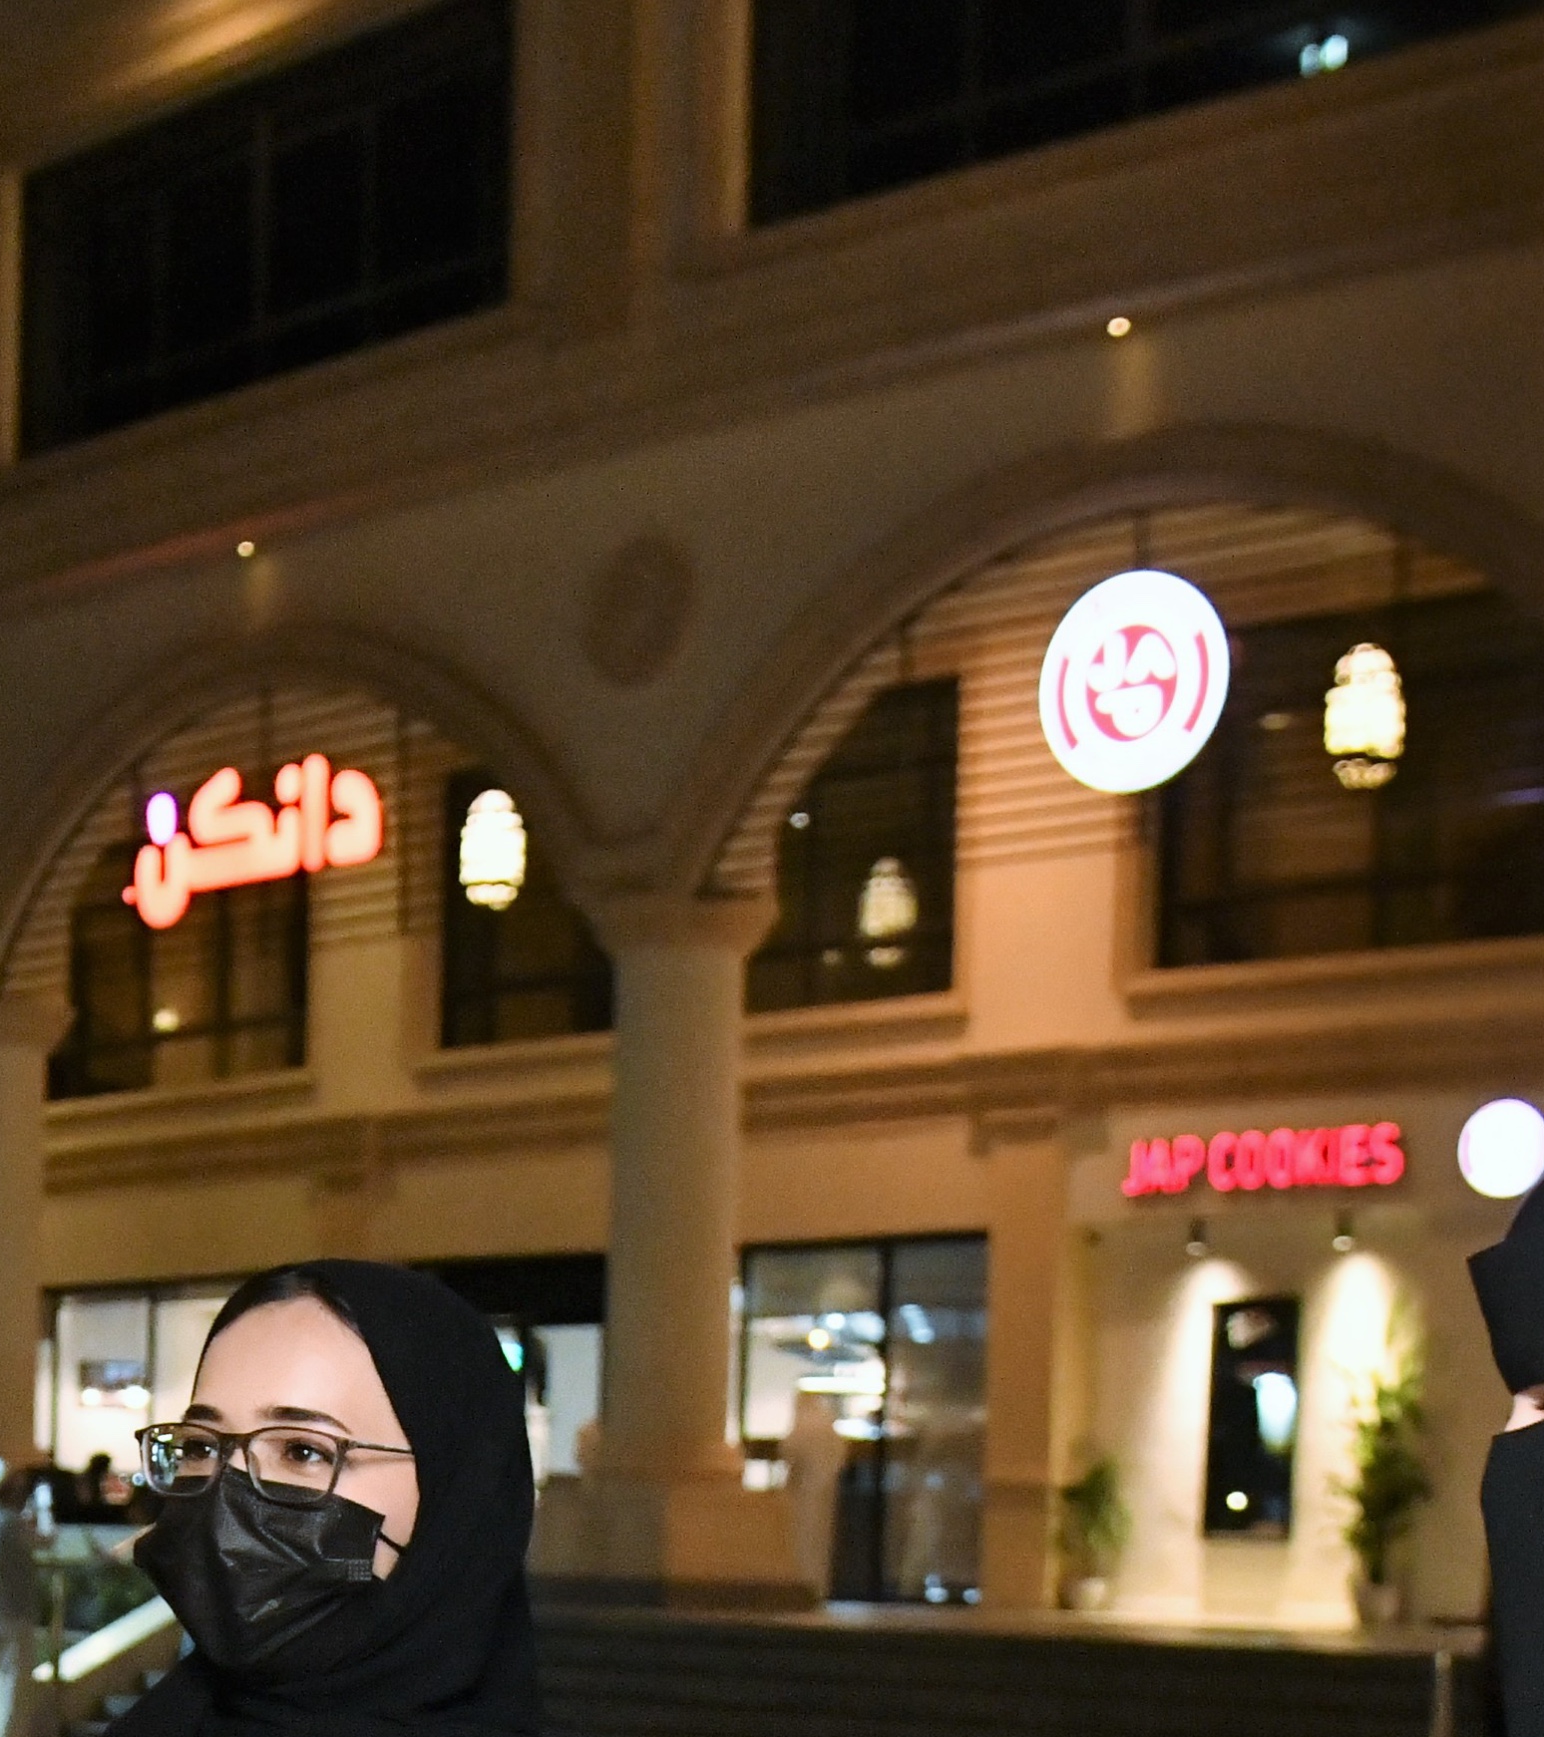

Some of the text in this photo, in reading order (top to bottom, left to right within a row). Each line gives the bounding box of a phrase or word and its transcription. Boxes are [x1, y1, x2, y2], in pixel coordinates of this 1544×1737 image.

[121, 753, 383, 929] دانكن
[1120, 1121, 1405, 1197] JAP COOKIES
